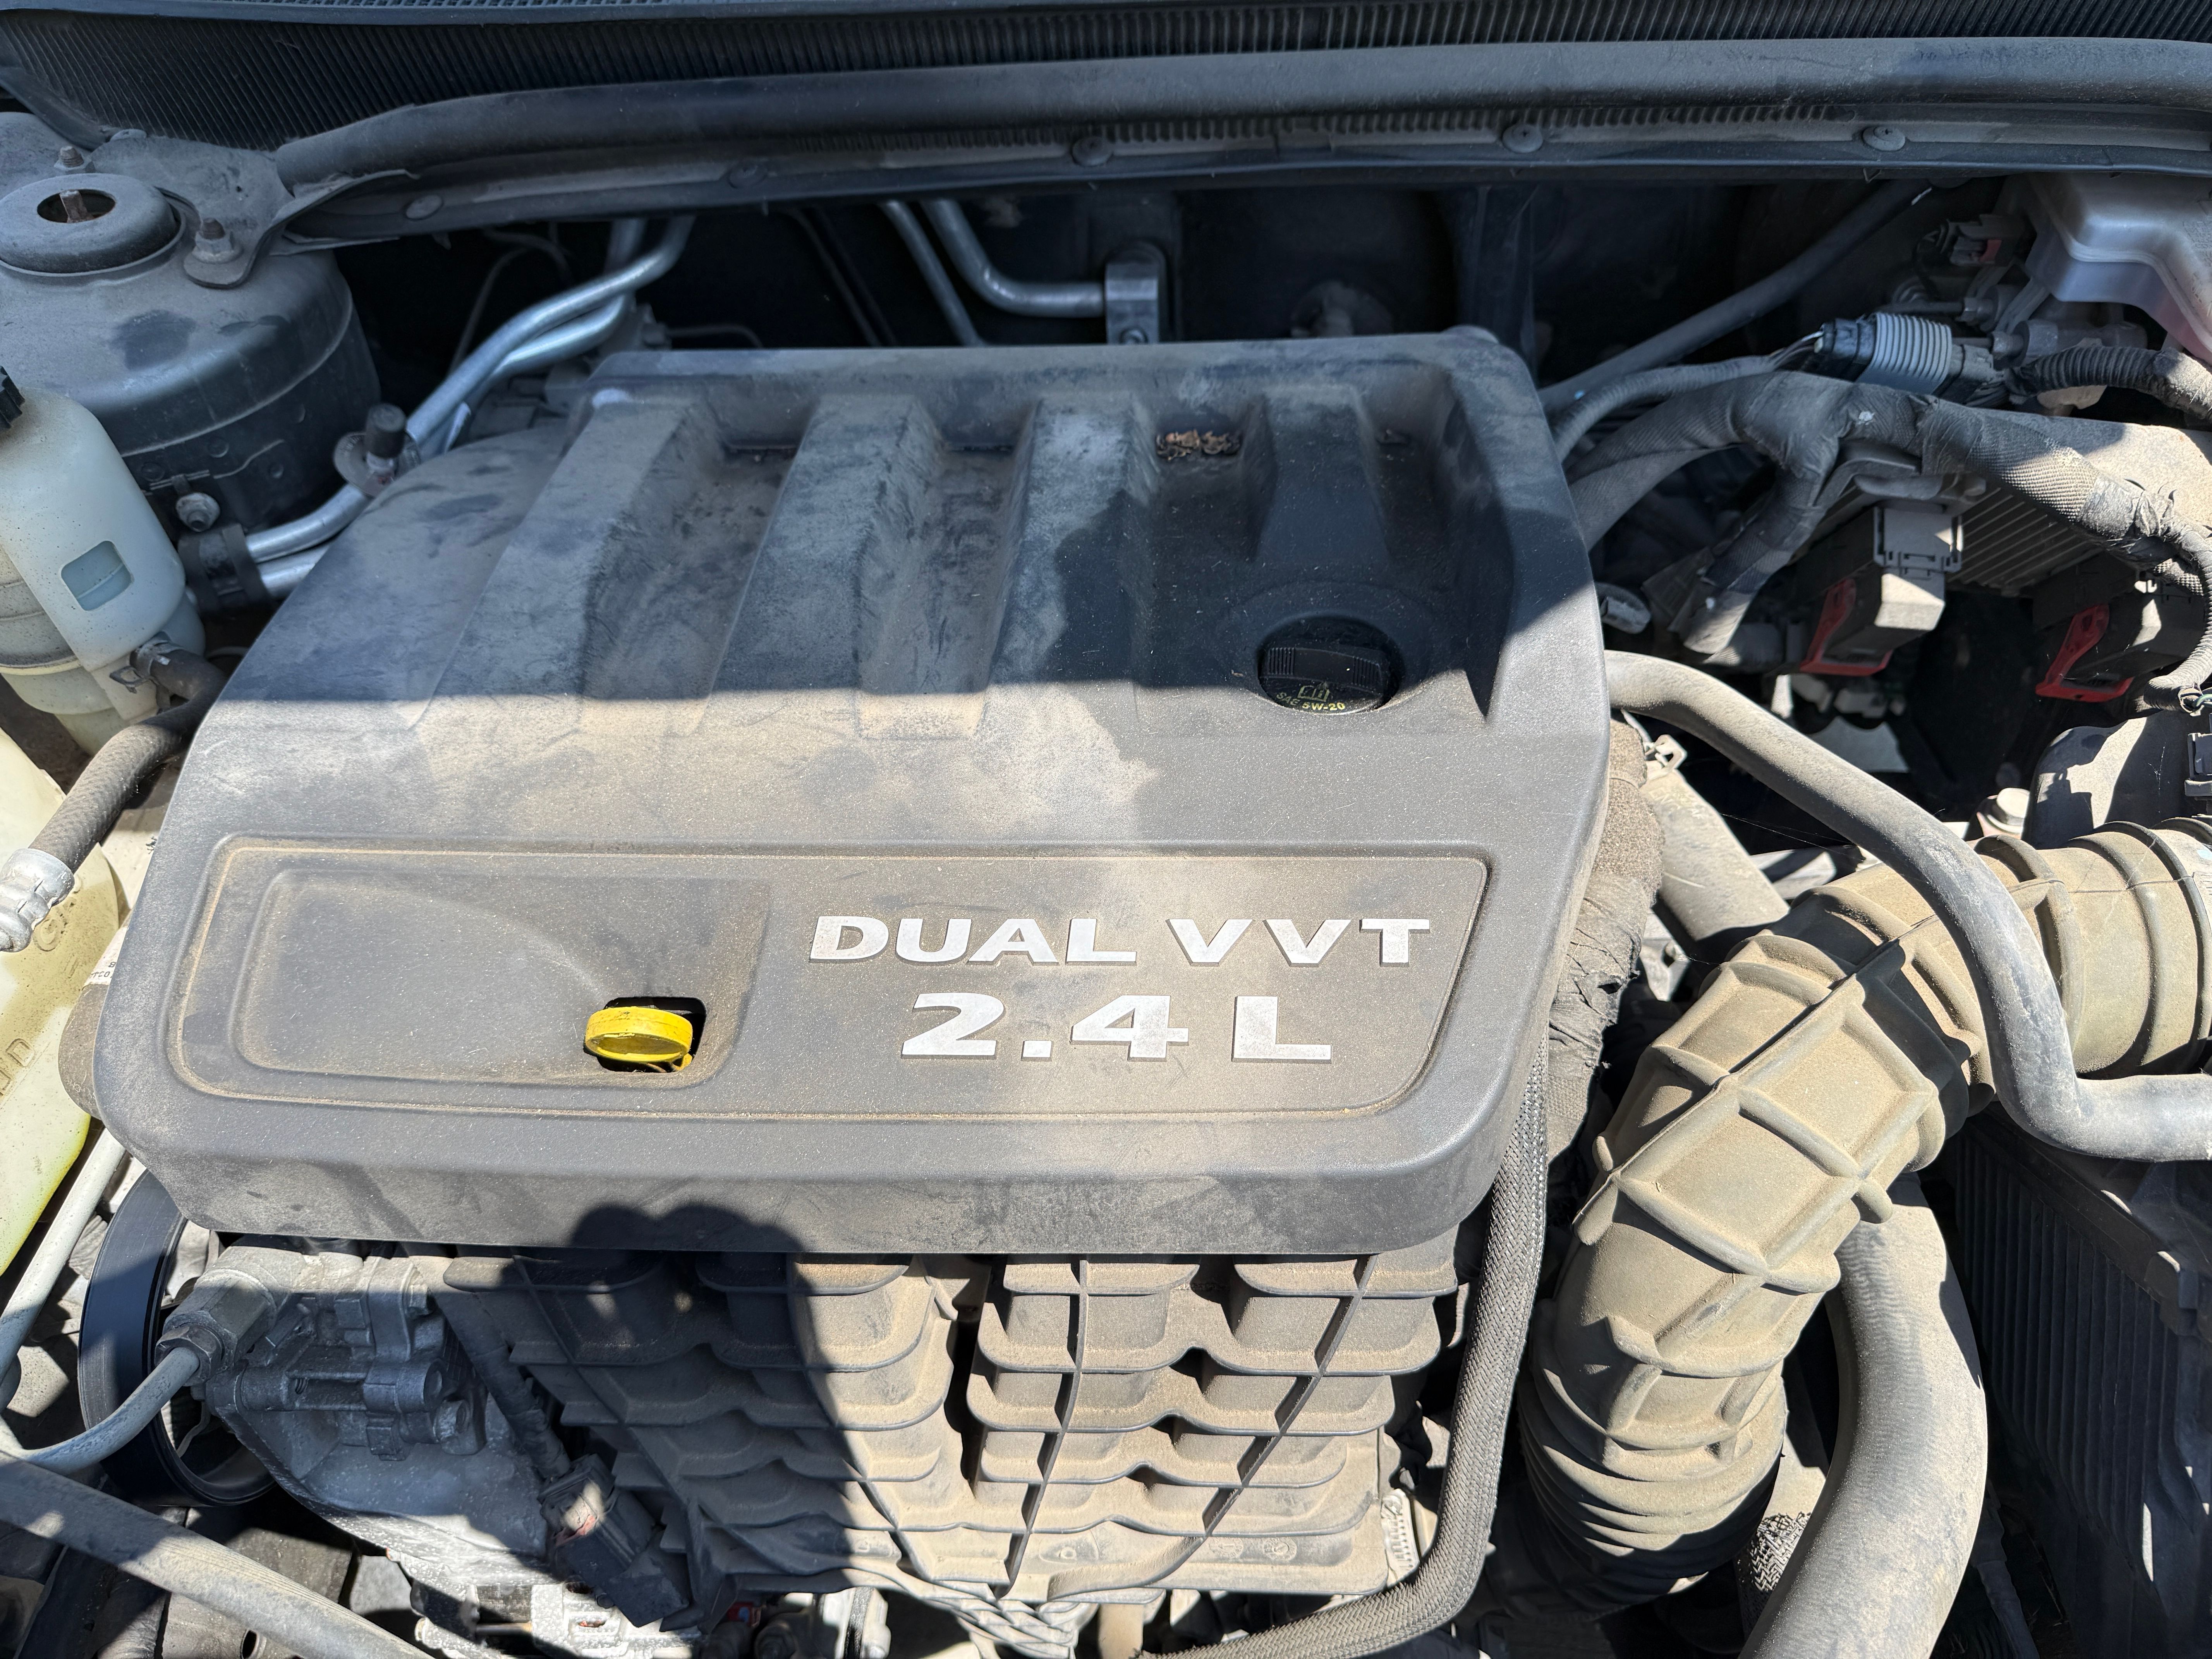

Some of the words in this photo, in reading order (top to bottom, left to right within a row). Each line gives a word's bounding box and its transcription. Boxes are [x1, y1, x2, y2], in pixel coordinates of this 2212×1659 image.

[1276, 692, 1300, 706] SAE
[1302, 701, 1345, 711] 5W-20
[809, 915, 1137, 965] DUAL
[1166, 918, 1430, 966] VVT
[901, 992, 1189, 1061] 2.4
[1232, 996, 1332, 1062] L
